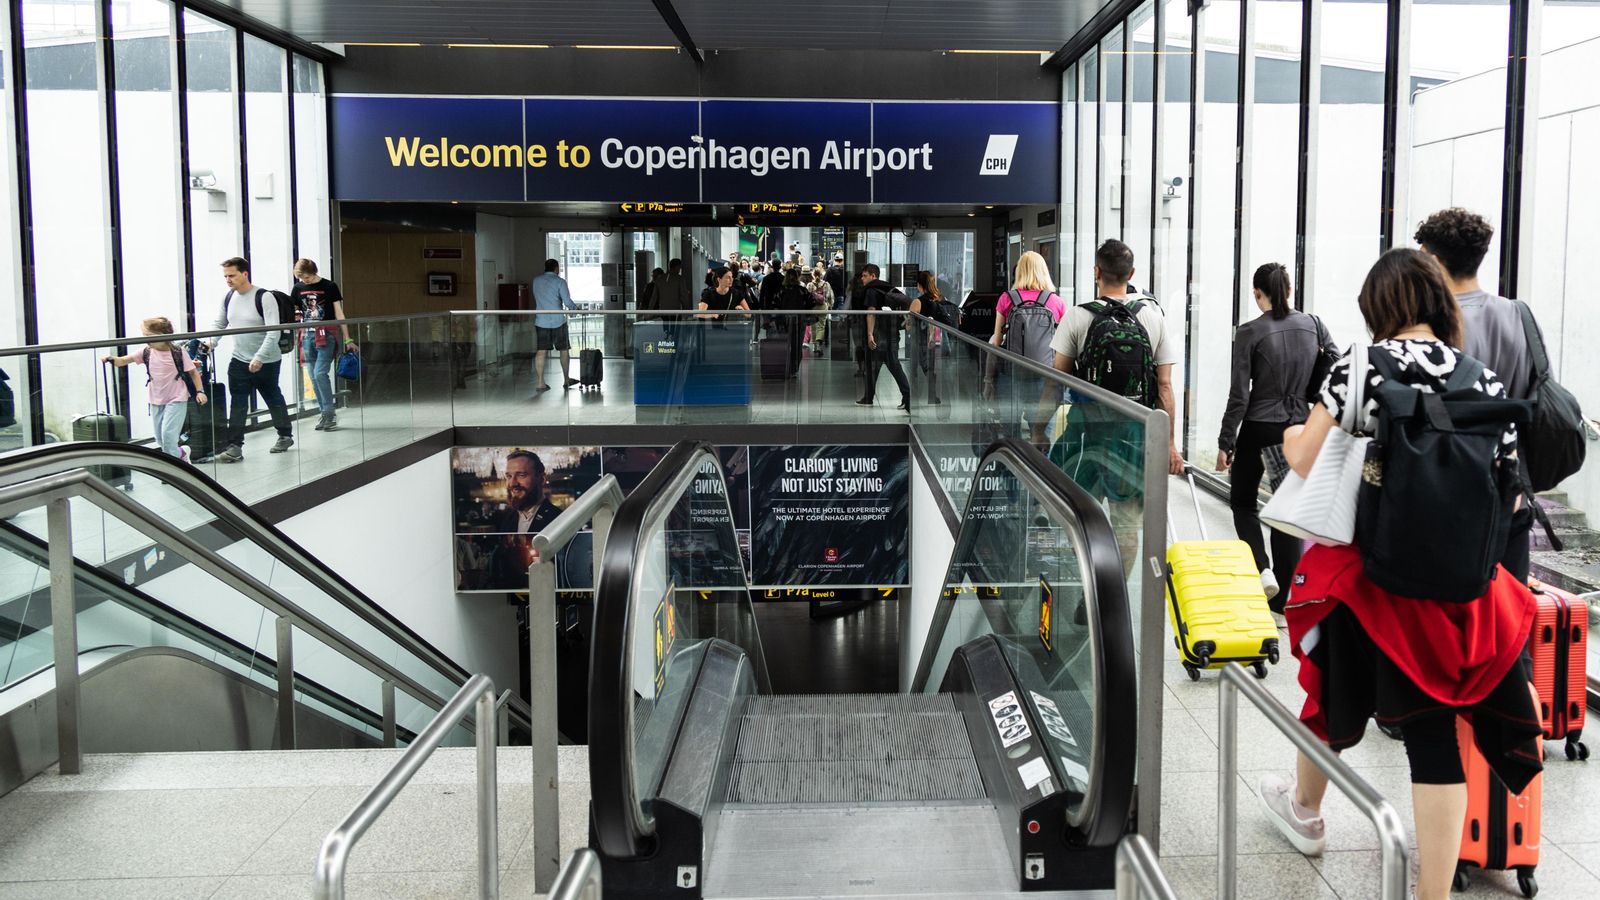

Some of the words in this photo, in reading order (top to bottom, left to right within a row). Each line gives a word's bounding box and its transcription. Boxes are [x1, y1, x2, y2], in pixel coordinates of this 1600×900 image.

[385, 136, 547, 168] Welcome
[557, 139, 590, 168] to
[601, 137, 811, 176] Copenhagen
[820, 139, 933, 178] Airport
[986, 158, 1007, 170] CPH
[649, 202, 663, 211] P7a
[763, 203, 777, 212] P7a
[971, 308, 992, 316] ATM
[841, 457, 878, 474] LIVING
[782, 477, 805, 493] NOT
[807, 476, 834, 493] JUST
[836, 477, 882, 493] STAYING
[846, 506, 890, 514] EXPERIENCE
[806, 514, 855, 522] COPENHAGEN
